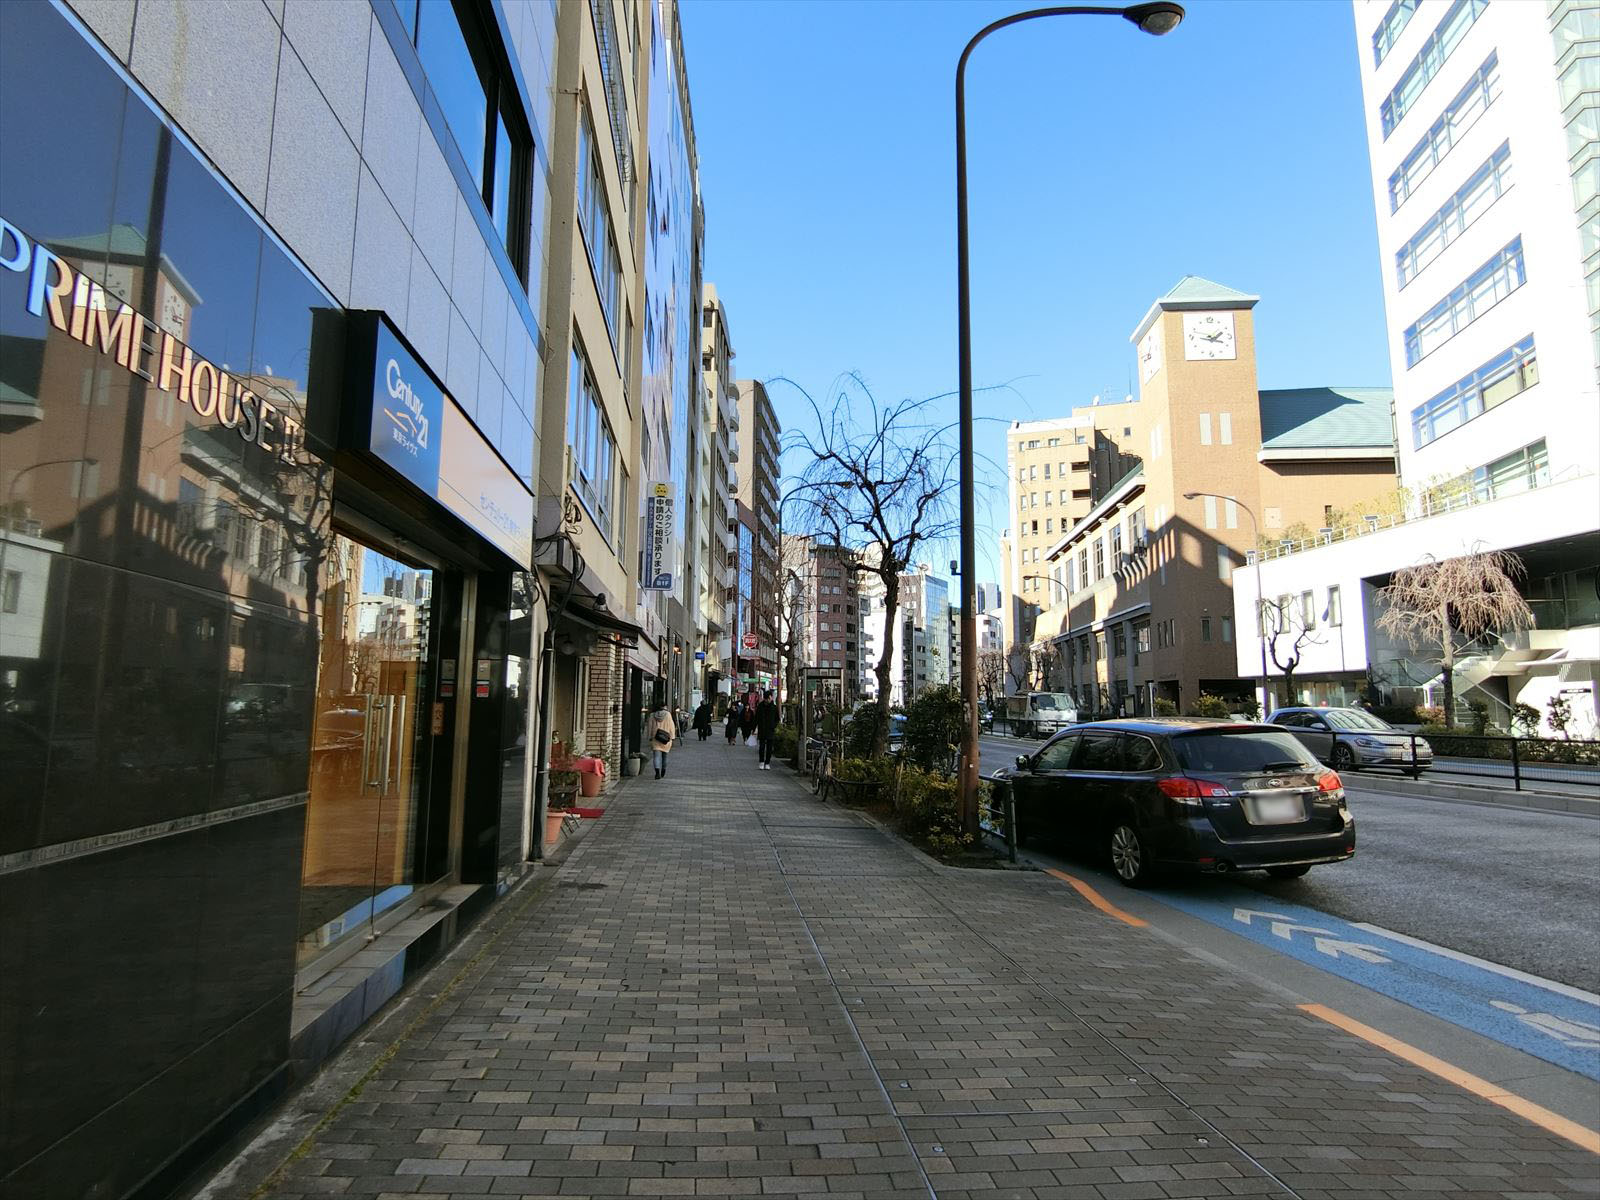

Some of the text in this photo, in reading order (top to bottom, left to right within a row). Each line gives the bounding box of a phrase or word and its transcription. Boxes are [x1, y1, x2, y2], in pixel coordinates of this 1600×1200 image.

[0, 215, 159, 382] PRIME
[158, 332, 276, 452] HOUSE
[654, 498, 665, 575] 申請のご相談承ります
[664, 498, 674, 545] 個人タクシー
